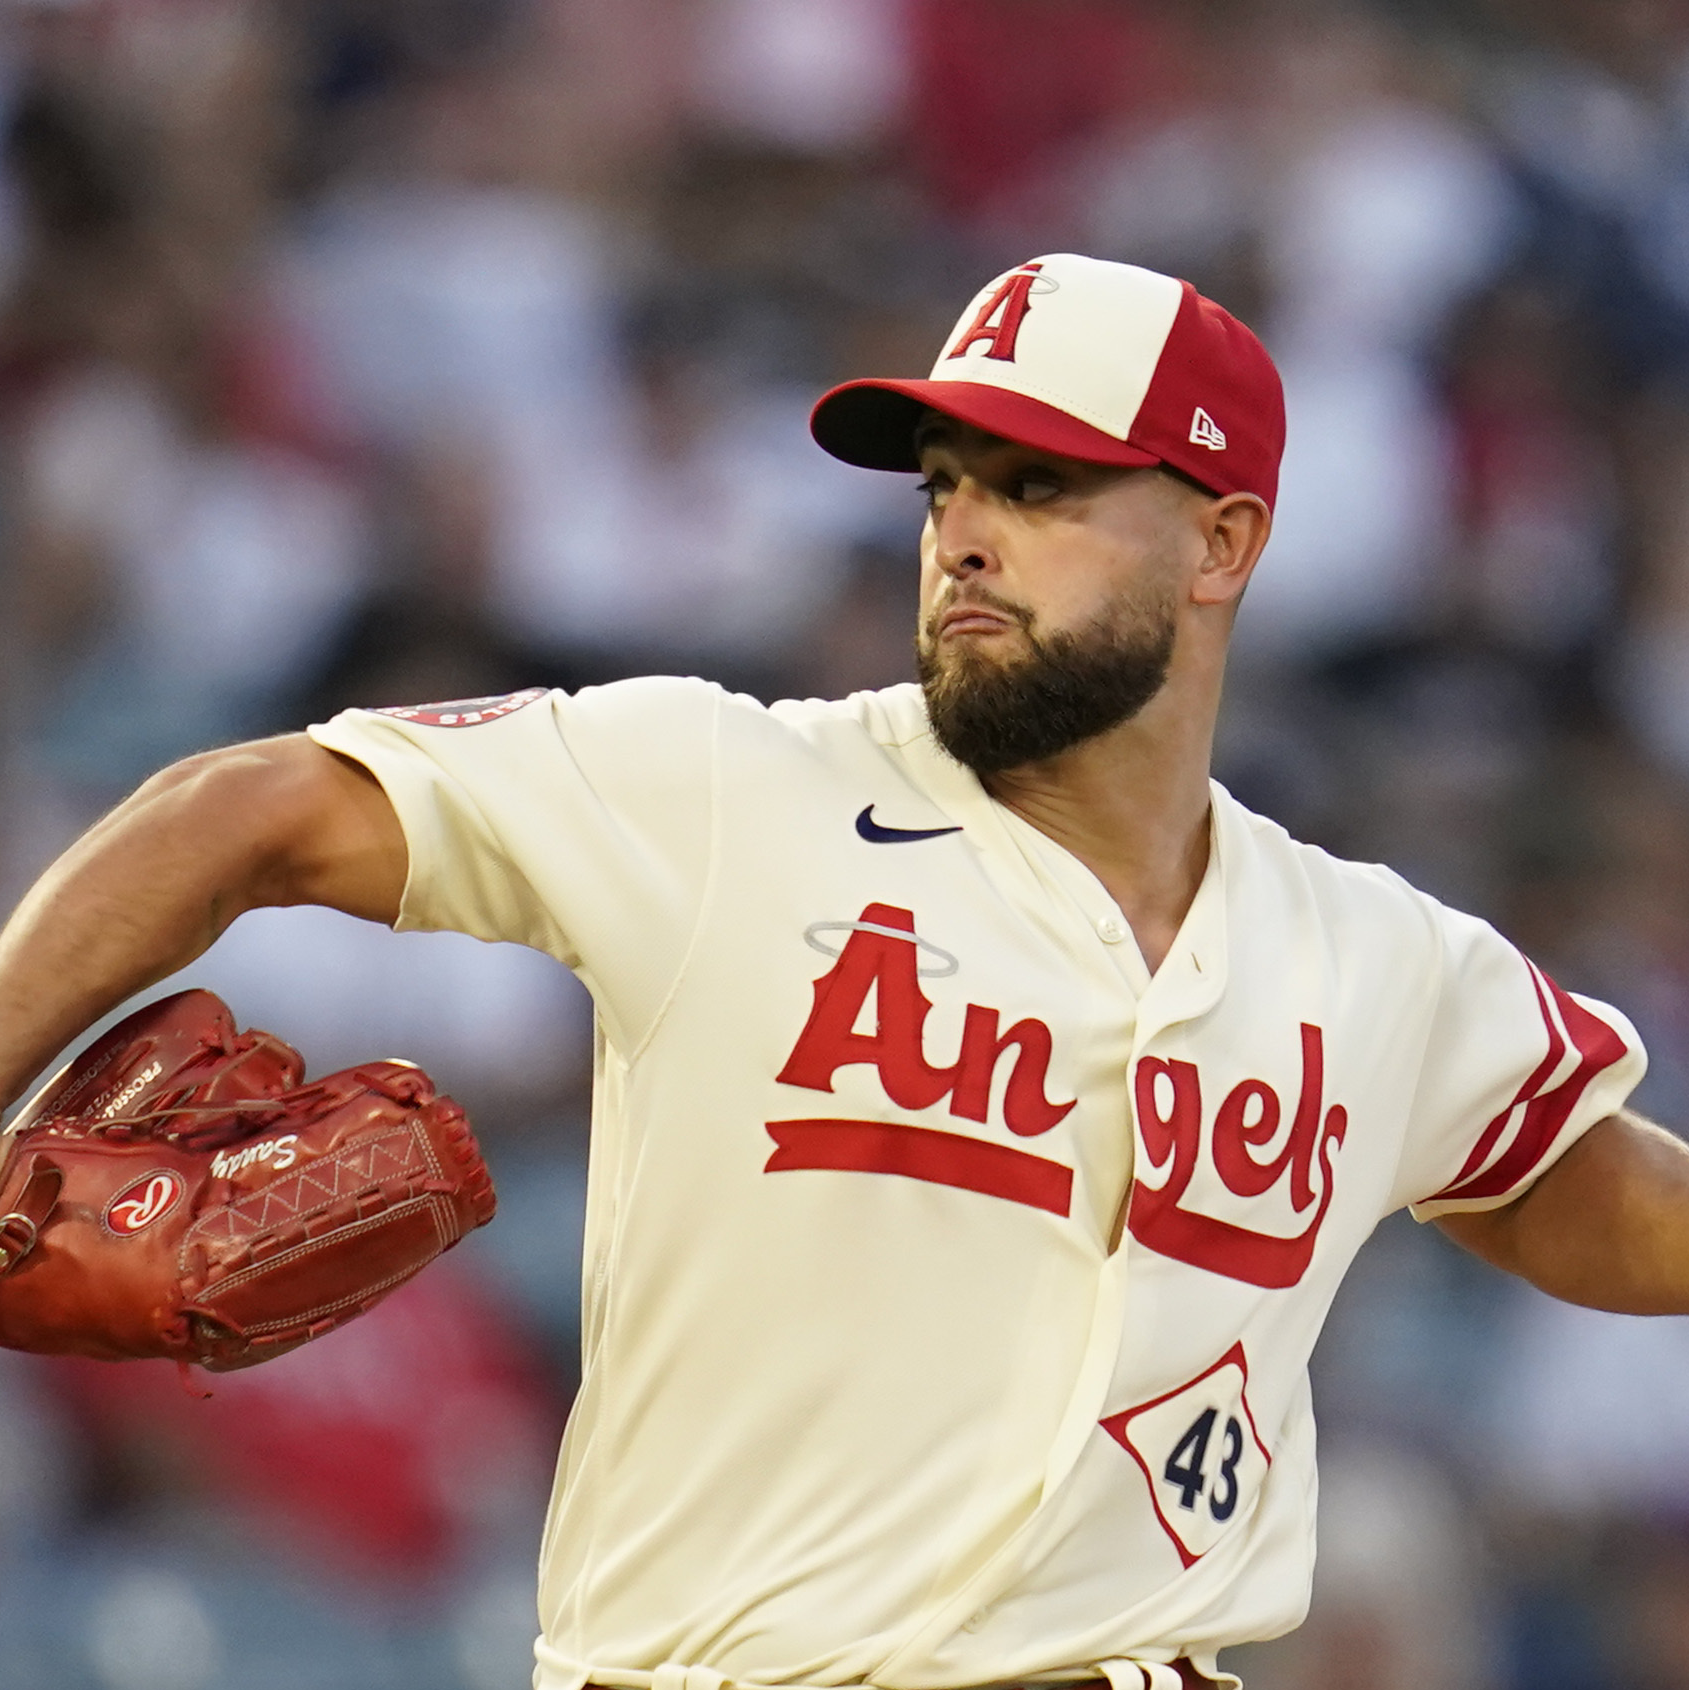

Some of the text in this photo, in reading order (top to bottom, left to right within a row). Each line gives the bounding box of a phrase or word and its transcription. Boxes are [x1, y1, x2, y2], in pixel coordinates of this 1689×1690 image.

[945, 263, 1044, 364] A
[775, 902, 1348, 1228] Angels
[209, 1133, 299, 1180] Sandy
[1162, 1405, 1245, 1523] 43
